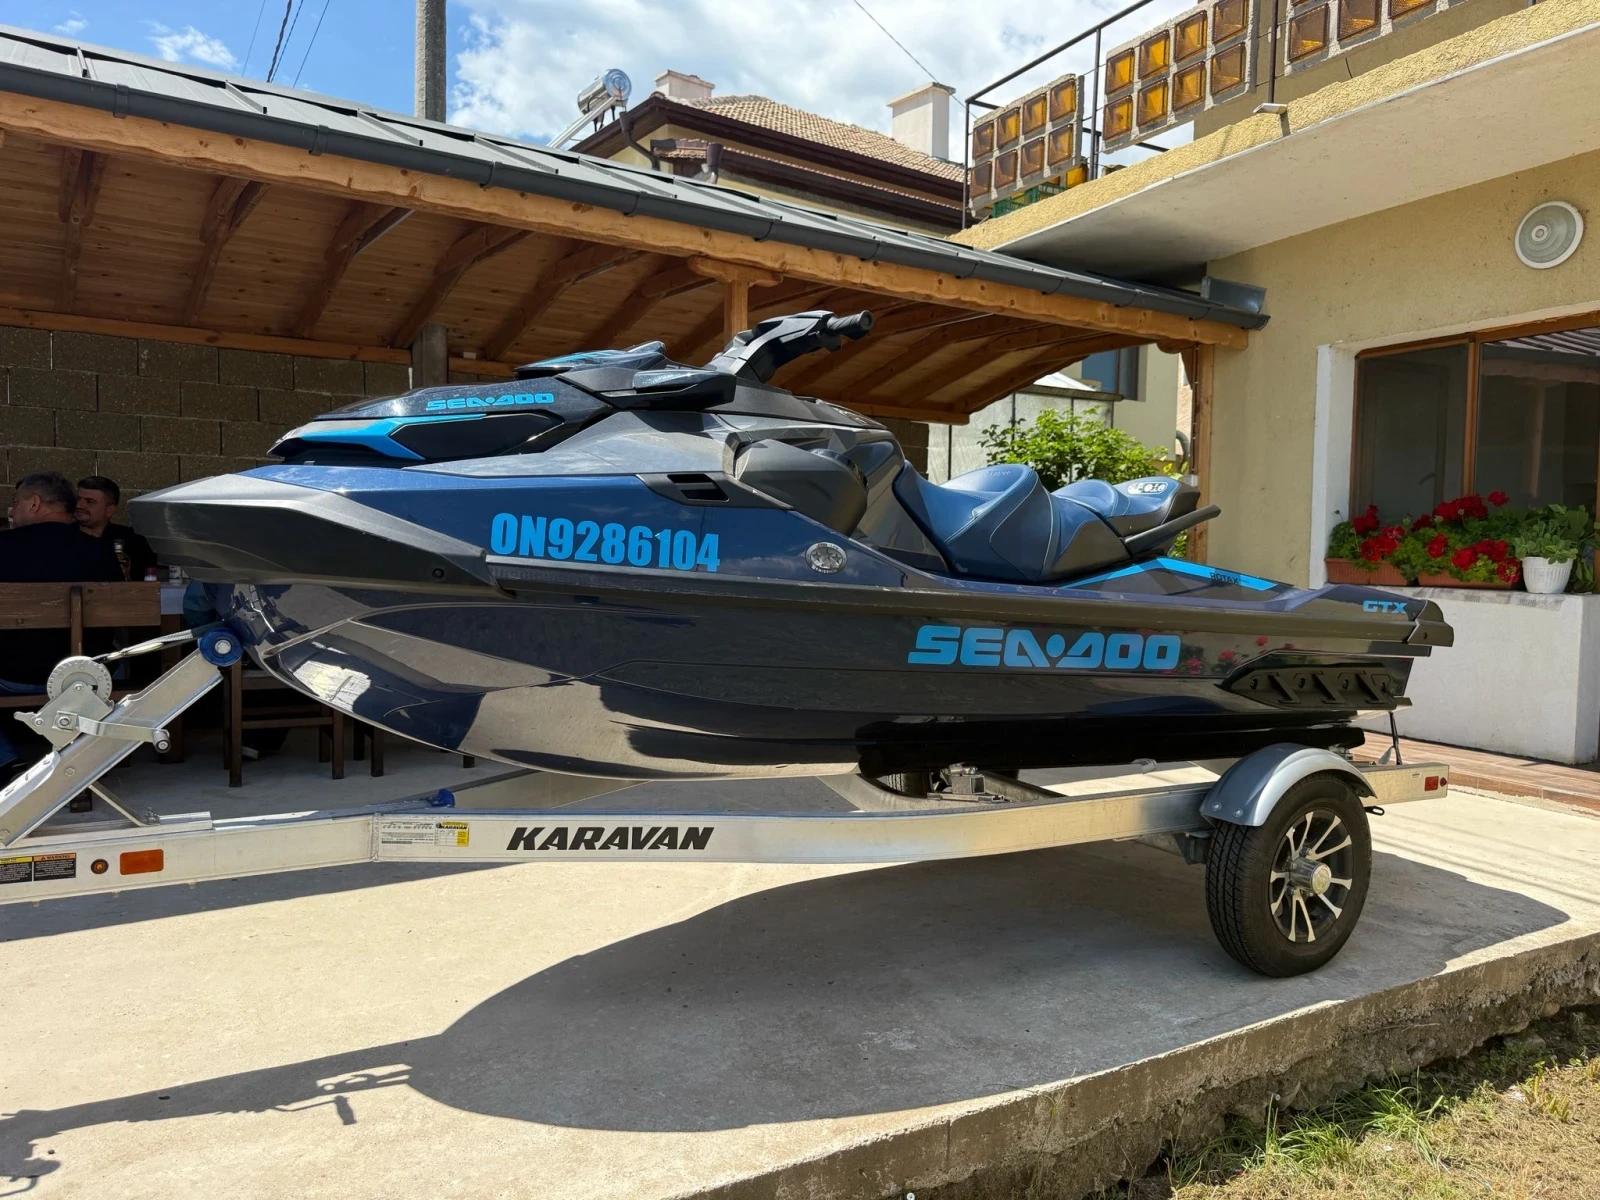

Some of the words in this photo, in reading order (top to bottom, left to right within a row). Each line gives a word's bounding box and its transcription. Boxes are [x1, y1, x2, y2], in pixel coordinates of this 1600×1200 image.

[490, 512, 720, 572] ON9286104
[1362, 600, 1407, 614] GTX
[506, 826, 715, 850] KARAVAN
